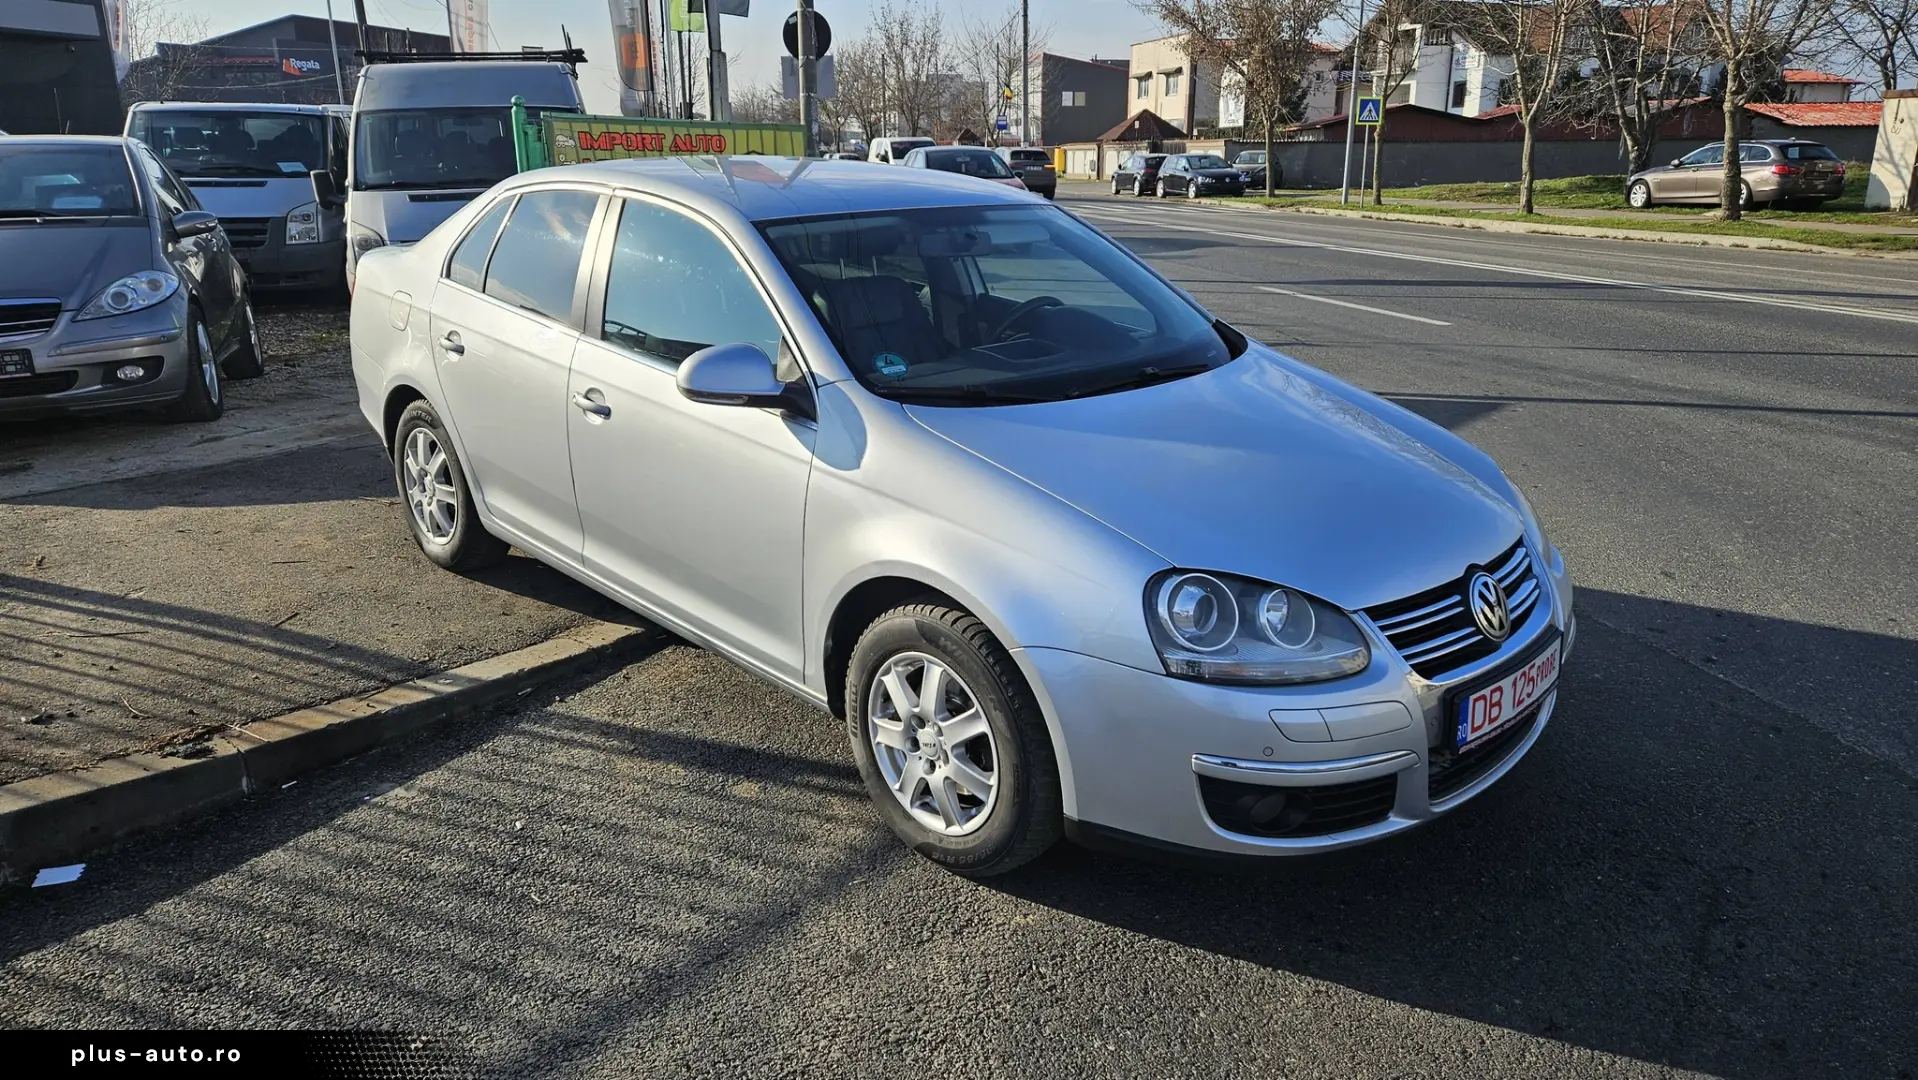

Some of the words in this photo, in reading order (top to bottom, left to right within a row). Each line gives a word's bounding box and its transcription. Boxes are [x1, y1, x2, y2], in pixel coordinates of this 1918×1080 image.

[290, 57, 320, 71] Regata
[578, 131, 666, 152] IMPORT
[669, 134, 726, 152] AUTO
[1470, 685, 1504, 734] DB
[1511, 663, 1535, 710] 125
[1457, 723, 1468, 741] RO
